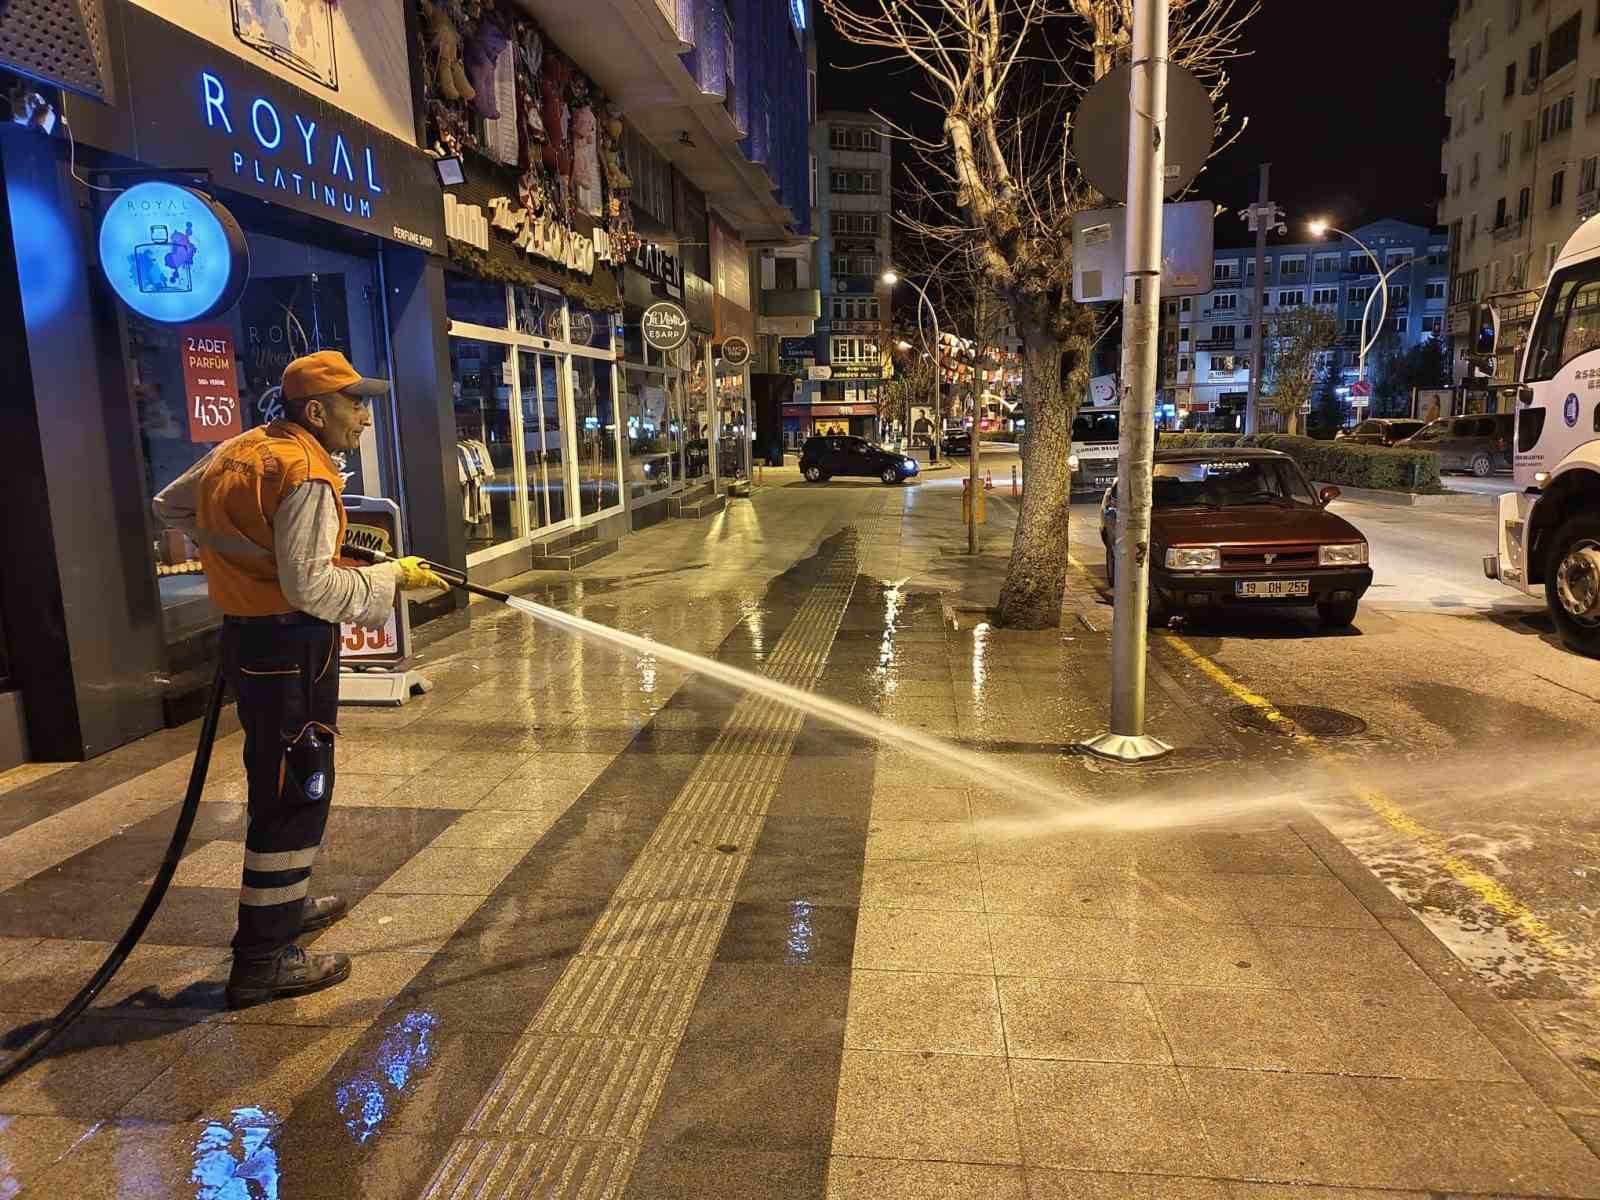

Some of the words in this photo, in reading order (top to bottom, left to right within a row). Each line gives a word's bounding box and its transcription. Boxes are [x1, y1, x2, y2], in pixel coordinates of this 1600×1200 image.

[202, 72, 382, 192] ROYAL
[233, 151, 371, 218] PLATINUM
[127, 199, 191, 211] ROYAL
[392, 226, 419, 245] PERFUME
[187, 337, 197, 352] 2
[198, 339, 227, 354] ADET
[189, 355, 230, 370] PARFÜM
[1246, 582, 1256, 594] 19
[1287, 581, 1308, 593] 255
